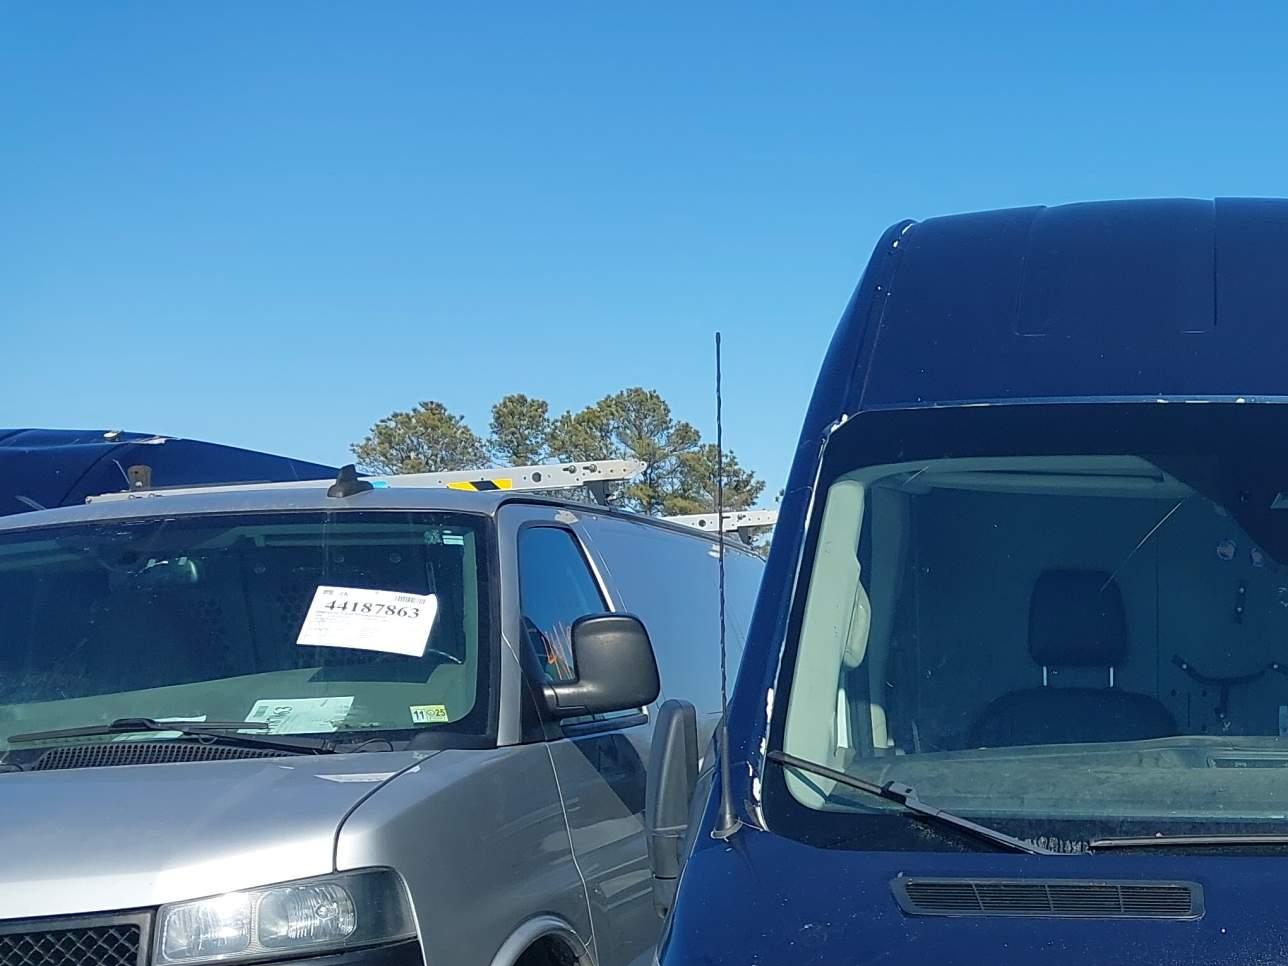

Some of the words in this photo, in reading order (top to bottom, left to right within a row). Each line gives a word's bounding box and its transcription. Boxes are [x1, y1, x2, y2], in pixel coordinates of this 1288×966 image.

[324, 599, 421, 619] 44187863
[413, 709, 425, 721] 11
[435, 708, 446, 718] 25
